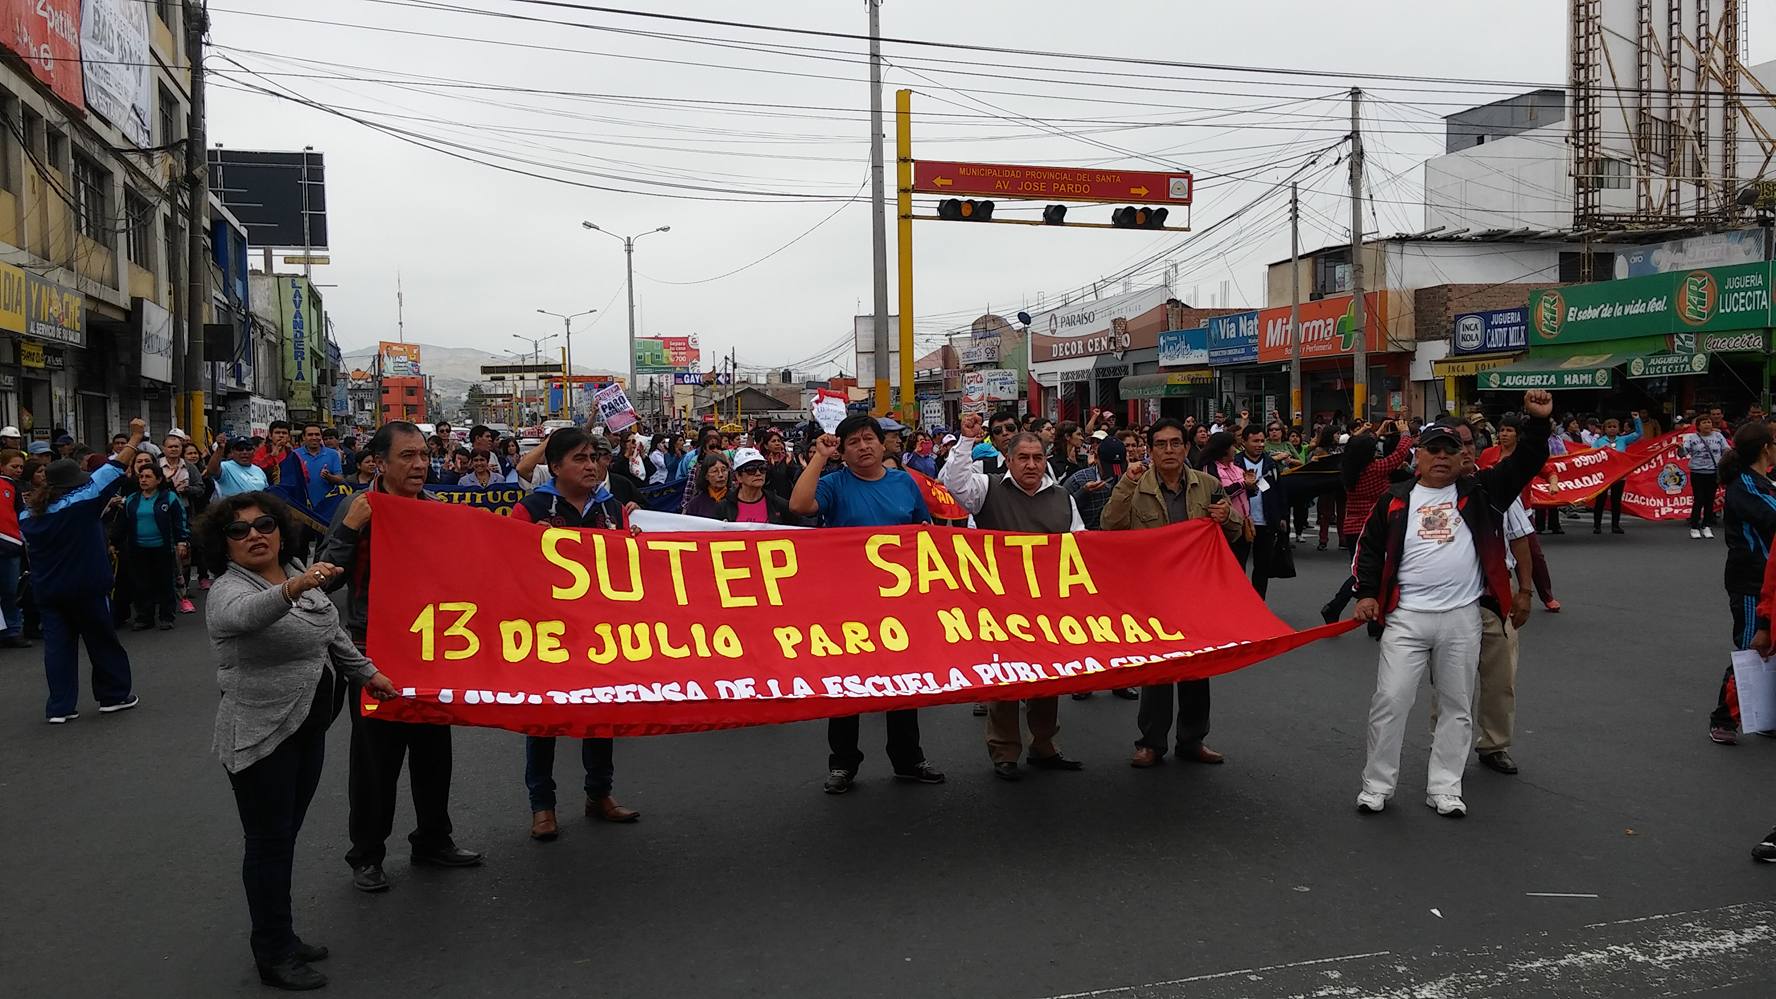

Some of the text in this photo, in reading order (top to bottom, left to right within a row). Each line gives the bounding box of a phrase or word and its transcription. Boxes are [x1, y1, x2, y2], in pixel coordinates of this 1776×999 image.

[959, 167, 1121, 183] MUNICIPALIDAD PROVINCIAL DEL SANTA
[1017, 182, 1047, 192] JOSE
[1052, 183, 1090, 194] PARDO
[4, 271, 22, 316] DIA
[31, 280, 39, 320] Y
[1719, 290, 1768, 313] LUCECITA
[1060, 308, 1096, 328] PARAÍSO
[1491, 312, 1521, 325] JUGUERIA
[1567, 306, 1576, 322] El
[1577, 304, 1603, 320] sabor
[1599, 303, 1613, 318] de
[1614, 302, 1623, 317] la
[1625, 299, 1646, 315] vida
[291, 279, 305, 381] LAVANDERIA
[1218, 319, 1236, 339] Vía
[1462, 323, 1479, 332] INCA
[1486, 326, 1526, 348] CANDY MILK
[1461, 333, 1479, 342] KOLA
[1052, 340, 1084, 358] DECOR
[1448, 362, 1497, 373] INCA KOLA
[1645, 364, 1691, 375] LUCECITA
[1648, 356, 1688, 365] JUGUERIA
[1502, 375, 1556, 386] JUGUERIA
[601, 395, 626, 414] PARO
[540, 527, 1099, 608] SUTEP SANTA
[409, 601, 1185, 665] 13 DE JULIO PARO NACIONAL
[821, 667, 973, 698] ESCUELA
[972, 653, 1106, 686] PÚBLICA
